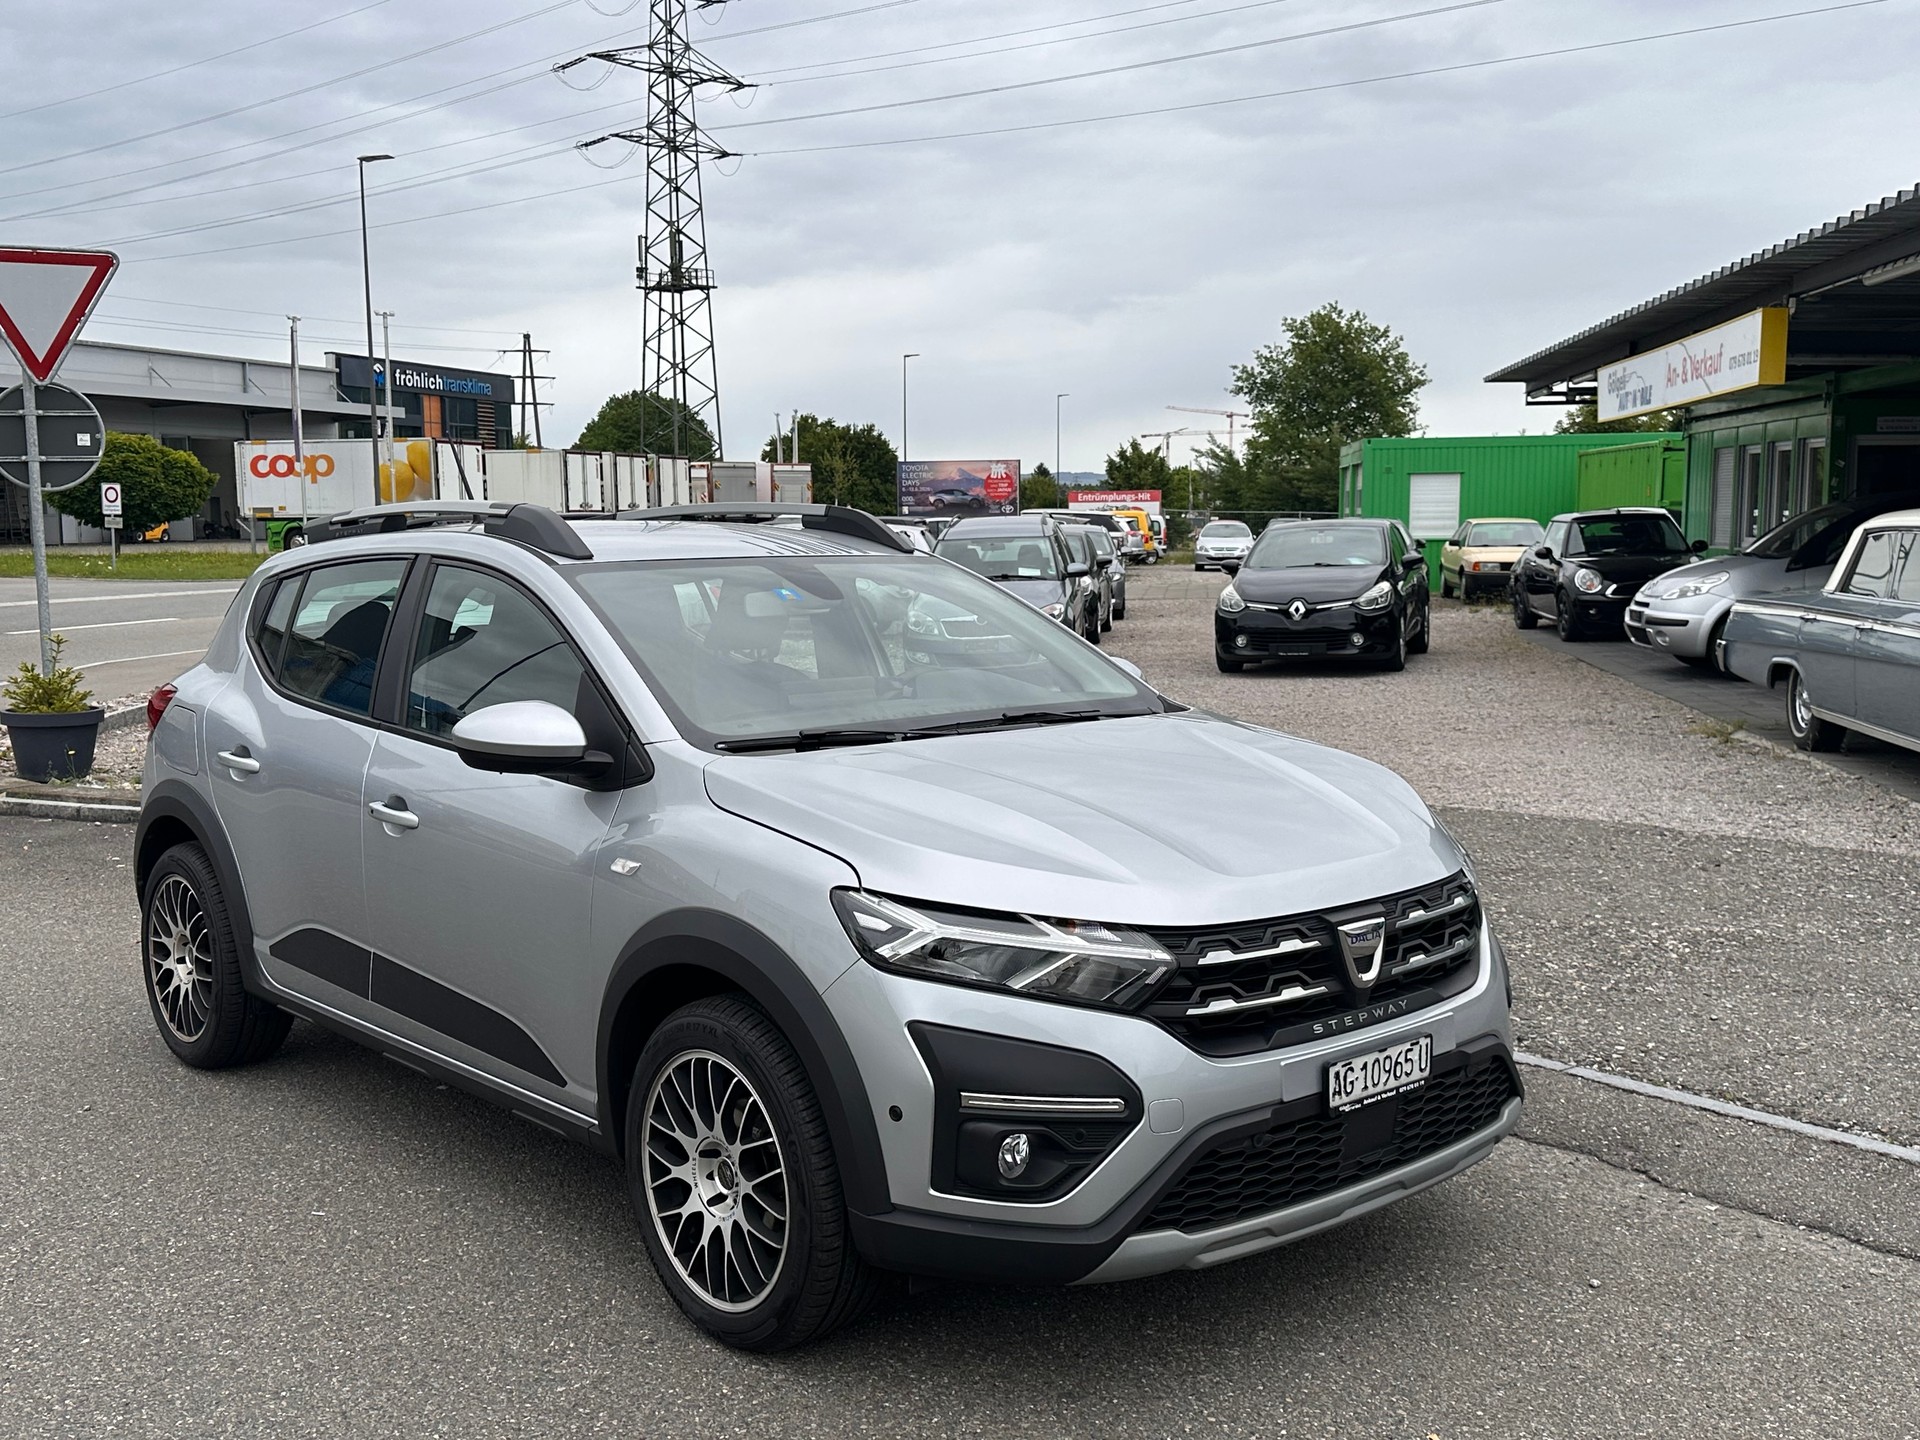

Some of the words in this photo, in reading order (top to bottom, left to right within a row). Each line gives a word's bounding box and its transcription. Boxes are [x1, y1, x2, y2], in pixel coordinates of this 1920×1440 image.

[1681, 356, 1688, 385] &
[1690, 343, 1723, 381] Verkauf
[395, 369, 492, 395] fröhlichtransklima
[1618, 385, 1653, 412] AUTMBILE
[250, 454, 335, 484] coop
[902, 464, 929, 472] TOYOTA
[1078, 492, 1151, 502] Entrümplungs-Hit
[1313, 1000, 1407, 1034] STEPWAY
[691, 1157, 699, 1189] WHEELS
